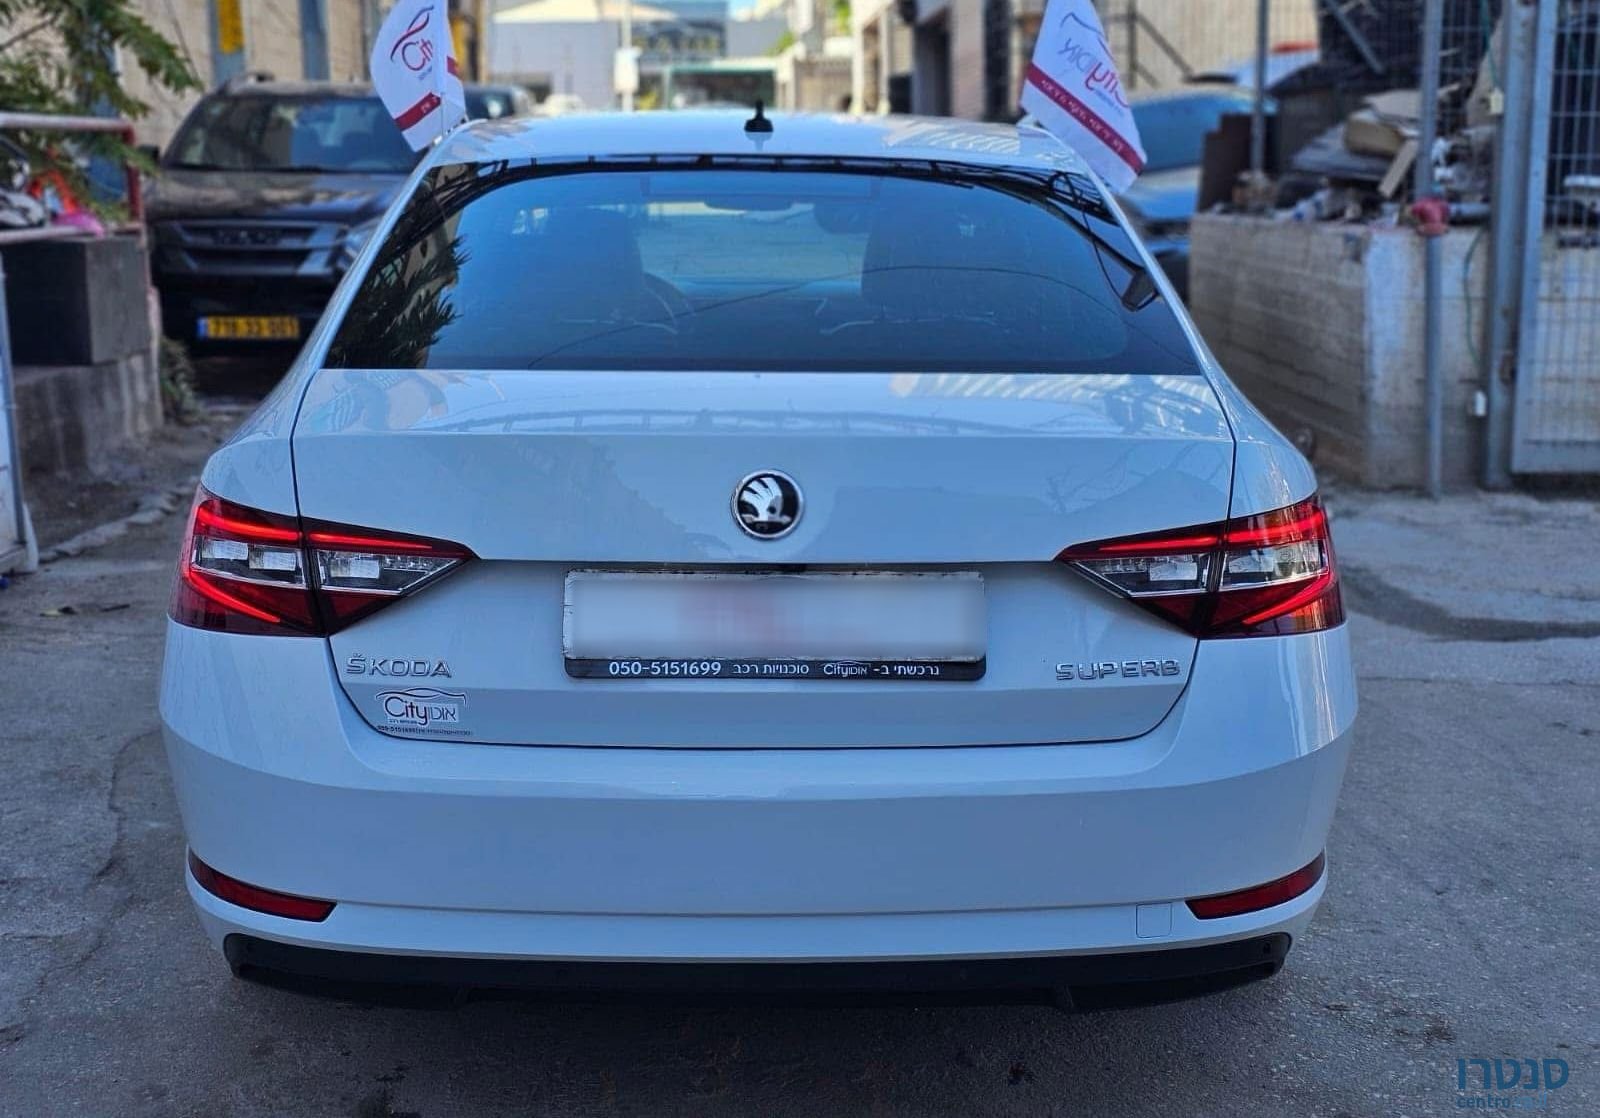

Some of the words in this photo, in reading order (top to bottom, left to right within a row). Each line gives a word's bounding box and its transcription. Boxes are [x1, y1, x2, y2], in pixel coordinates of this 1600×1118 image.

[346, 652, 452, 678] ŠKODA
[608, 661, 722, 676] 050-5151699
[732, 664, 759, 674] רכב
[763, 664, 810, 674] סוכנויות
[894, 664, 940, 675] נרכשתי
[1056, 659, 1181, 681] SUPERB
